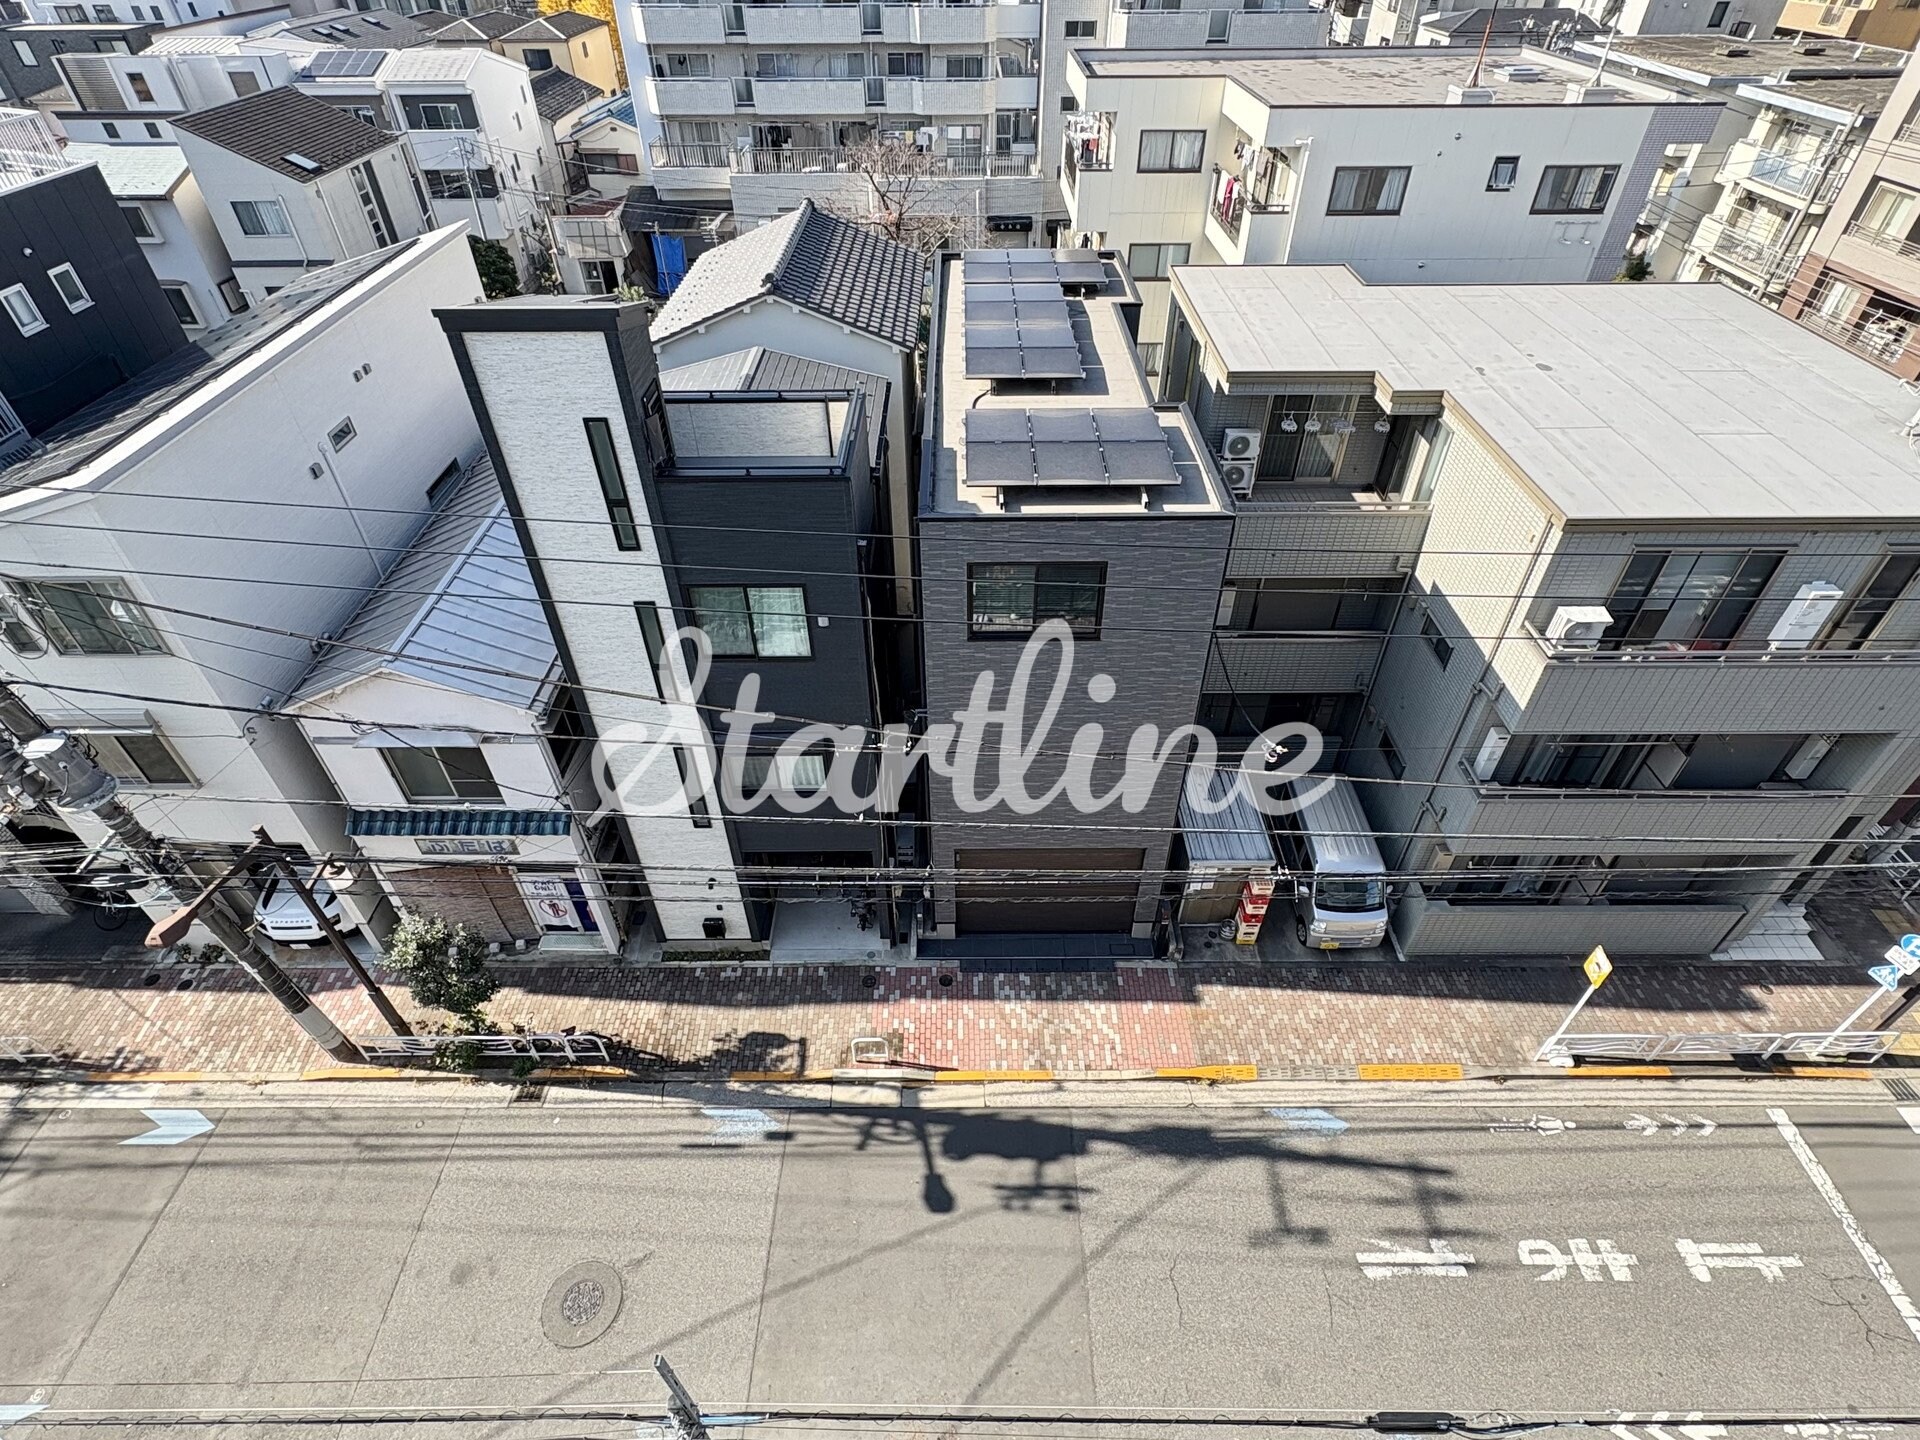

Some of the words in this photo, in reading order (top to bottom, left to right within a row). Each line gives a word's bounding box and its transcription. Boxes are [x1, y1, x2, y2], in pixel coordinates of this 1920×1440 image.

[428, 840, 508, 853] ふたば
[1356, 1237, 1804, 1282] 止まれ
